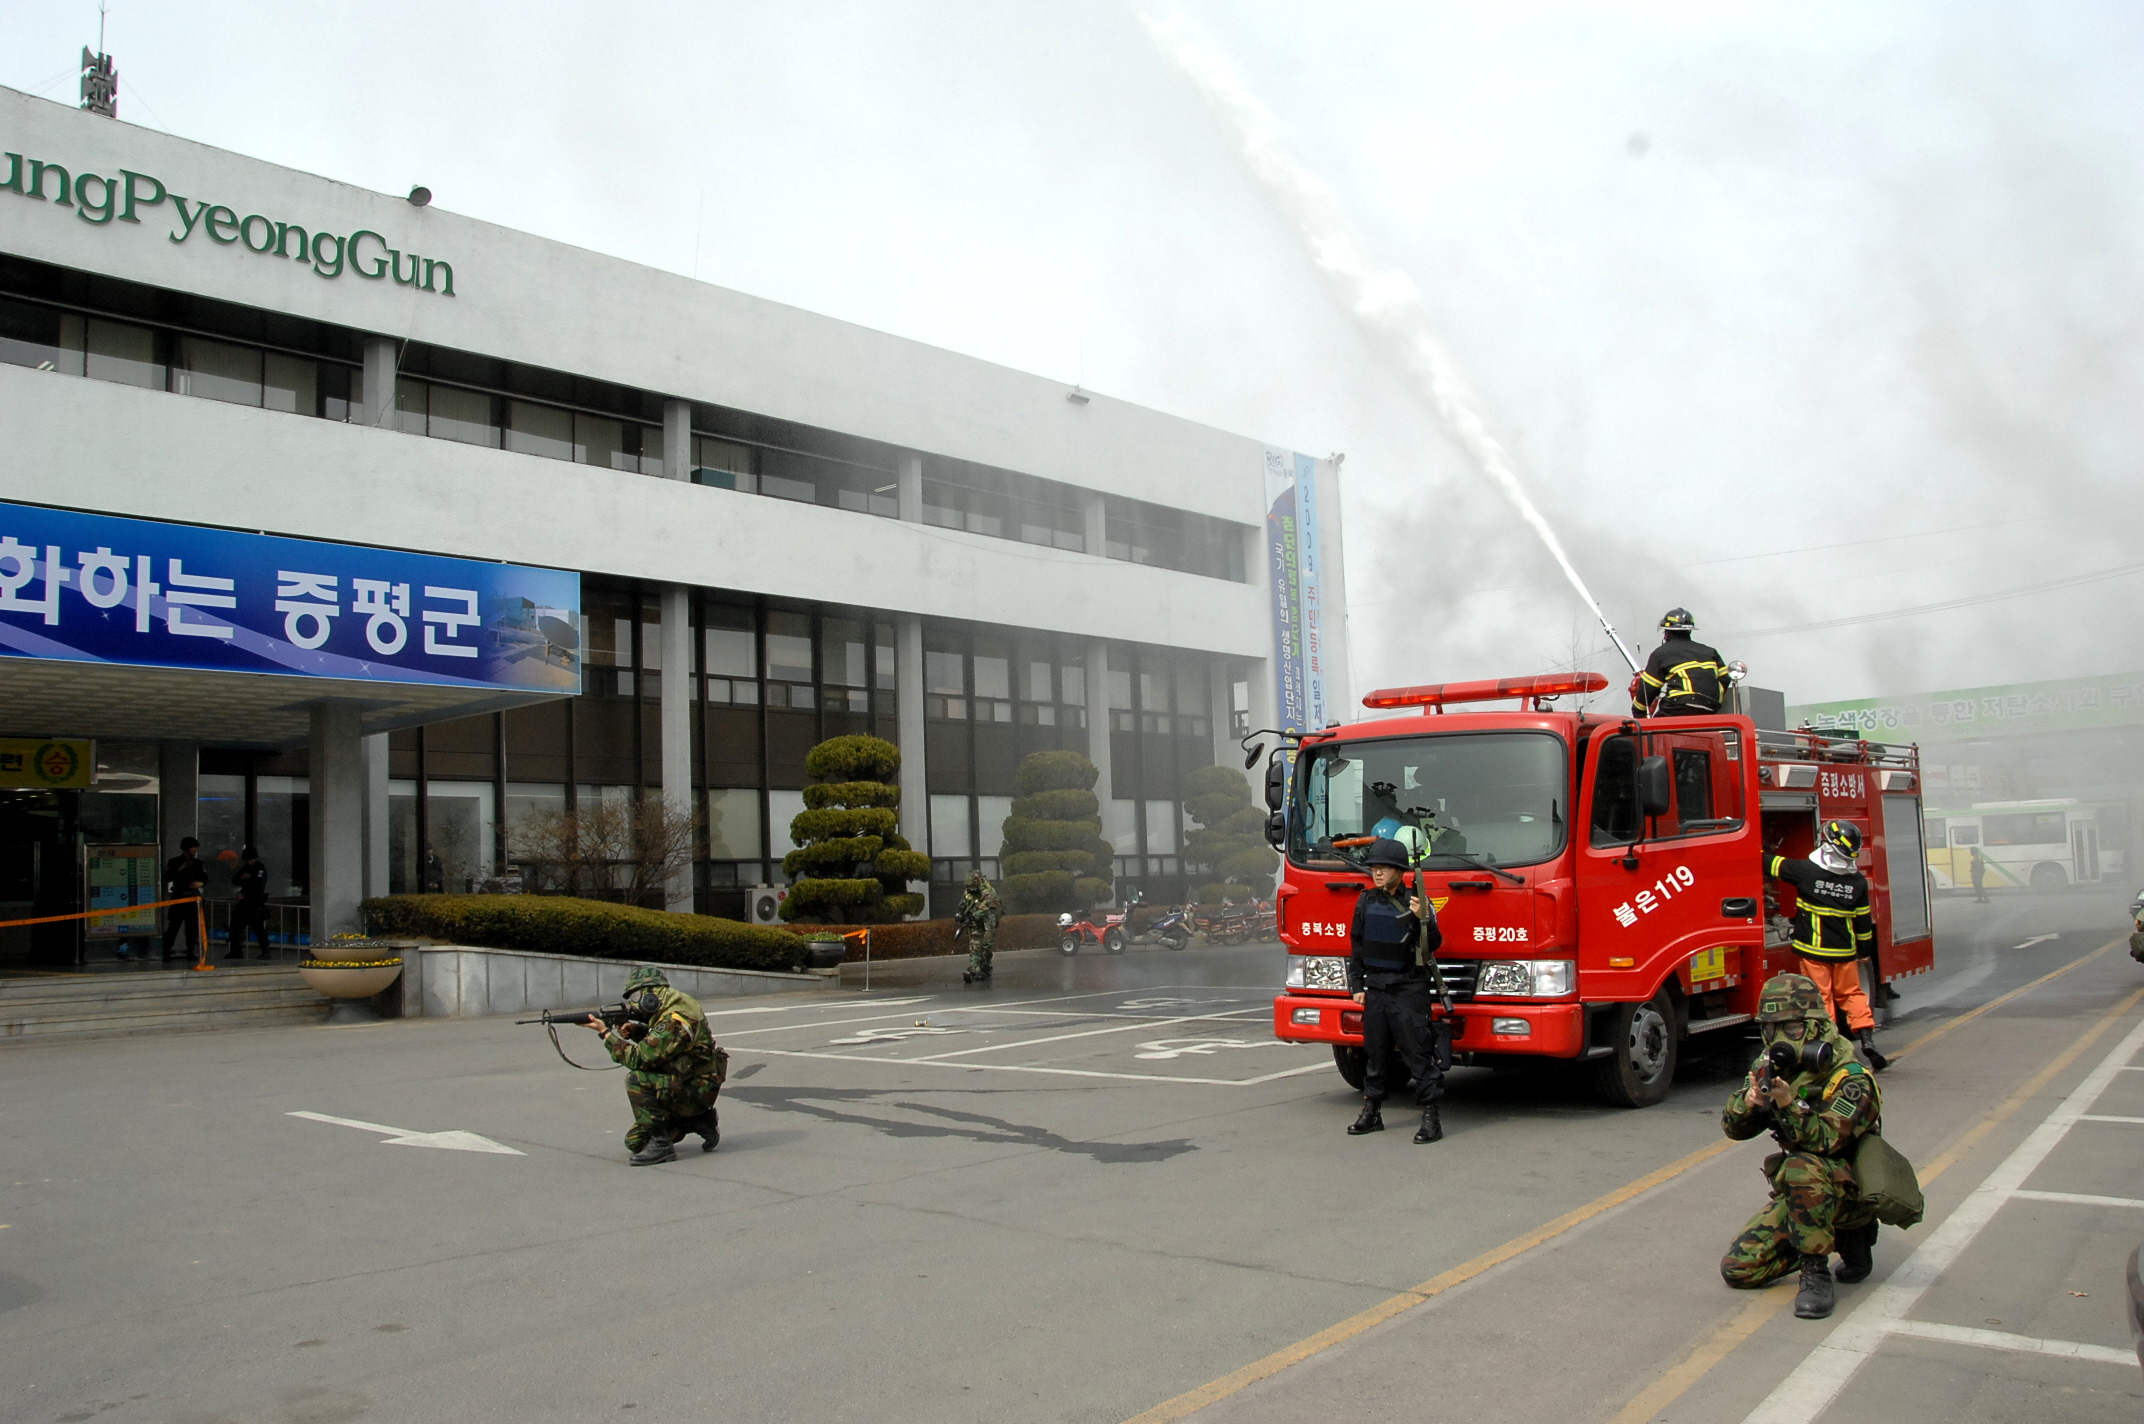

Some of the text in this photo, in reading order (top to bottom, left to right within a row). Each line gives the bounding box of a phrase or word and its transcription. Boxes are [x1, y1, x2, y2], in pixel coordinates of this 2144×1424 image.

[1274, 542, 1286, 573] 국가
[274, 570, 481, 659] 증평군
[1278, 579, 1289, 624] 유일의
[1308, 586, 1319, 677] 주민등록
[1281, 630, 1296, 721] 생명산업단지
[1817, 705, 1921, 730] 녹색성장을
[1929, 698, 1976, 724] 통한
[1982, 687, 2100, 718] 저탄소사회
[1821, 772, 1865, 798] 증평소방서
[1814, 879, 1854, 894] 충북소방
[1301, 922, 1346, 937] 충북소방
[1473, 926, 1529, 943] 증평 20호
